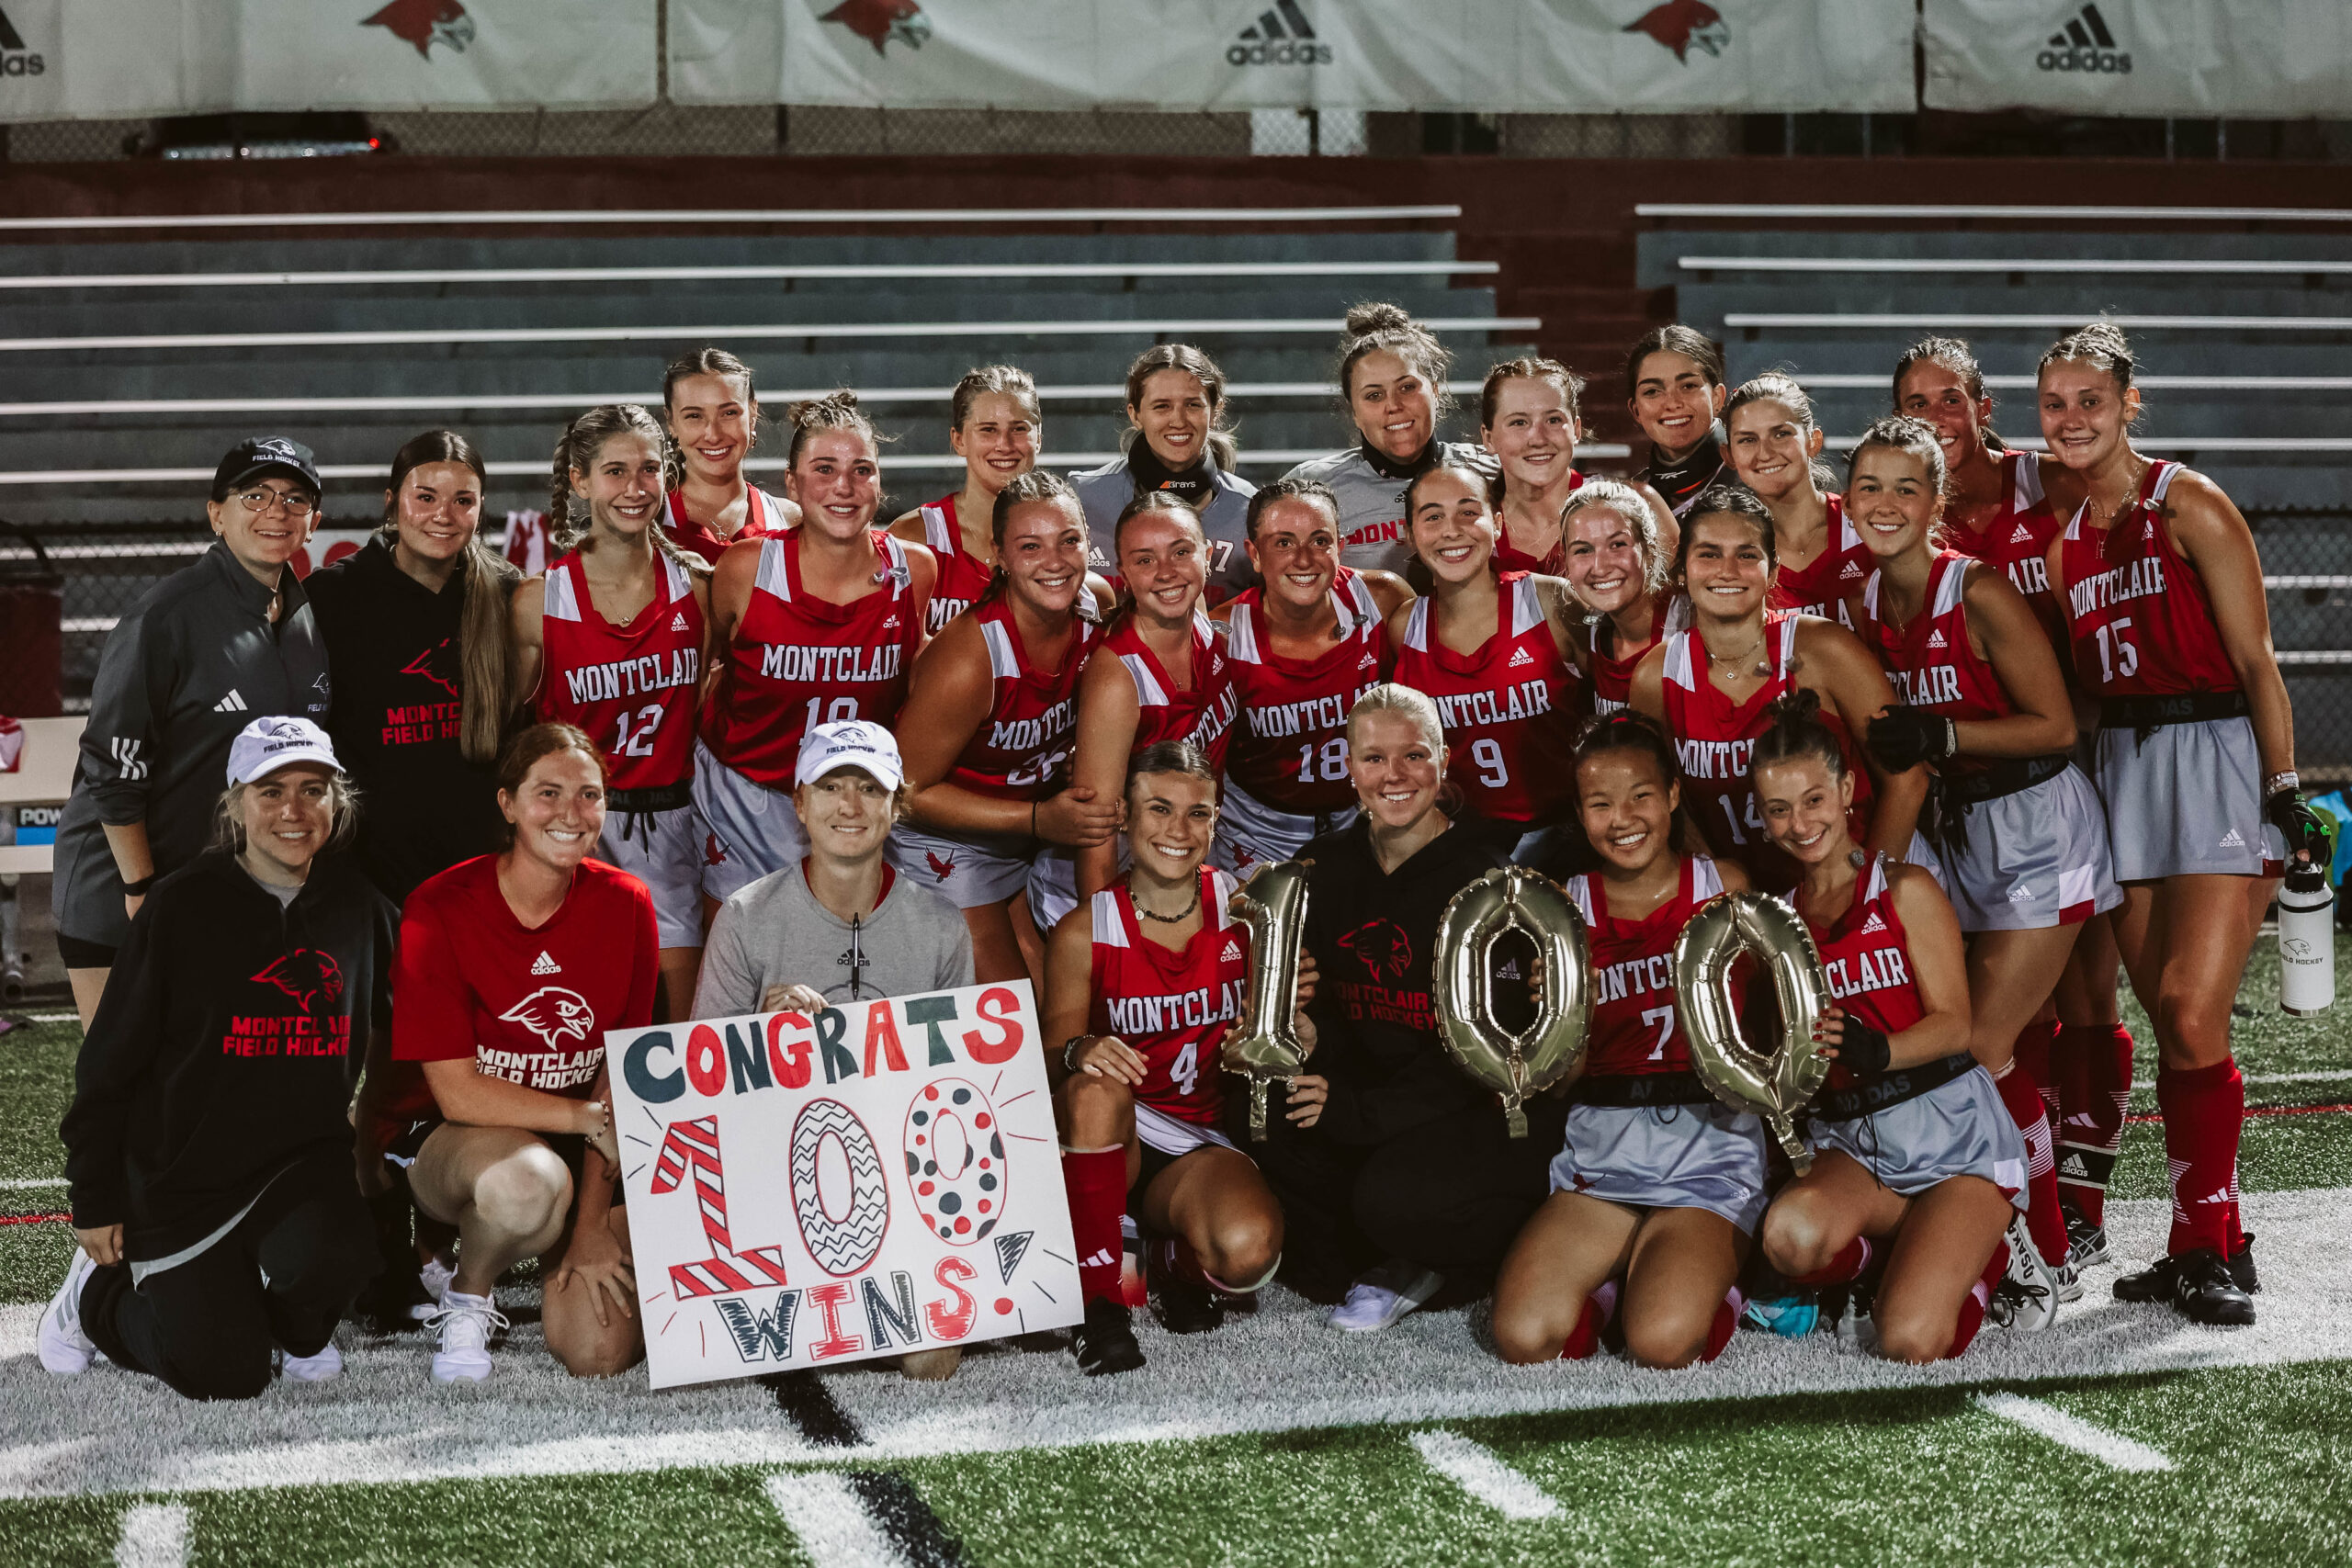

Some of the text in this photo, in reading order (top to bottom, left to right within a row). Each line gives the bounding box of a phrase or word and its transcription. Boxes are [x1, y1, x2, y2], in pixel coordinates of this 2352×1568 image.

[0, 51, 45, 77] as
[1227, 41, 1333, 66] adidas
[2037, 48, 2132, 74] adidas
[252, 454, 300, 468] FIELD HOCKEY
[2009, 534, 2033, 544] adidas
[1088, 558, 1111, 567] didas
[1839, 571, 1864, 580] adidas
[761, 643, 901, 682] MONTCLAIR
[1509, 656, 1534, 668] adidas
[2096, 617, 2138, 682] 15
[565, 648, 698, 705] MONTCLAIR
[1246, 681, 1380, 738] MONTCL
[382, 724, 434, 745] FIELD
[611, 704, 664, 757] 12
[264, 742, 284, 753] FIELD
[826, 745, 846, 754] FIELD
[1298, 738, 1350, 783] 18
[1472, 739, 1509, 788] 9
[2219, 840, 2245, 848] adidas
[531, 965, 562, 976] adidas
[837, 958, 871, 966] adias
[1826, 947, 1909, 999] CLAIR
[1106, 978, 1246, 1035] MONTCLAI
[623, 987, 1024, 1104] CONGRATS
[1641, 1005, 1674, 1060] 7
[223, 1036, 278, 1056] FIELD
[477, 1044, 605, 1072] MONTCLAIR
[531, 1064, 599, 1089] HOCKE
[1170, 1043, 1199, 1095] 4
[650, 1077, 1008, 1302] 100
[713, 1231, 1035, 1362] WINS!
